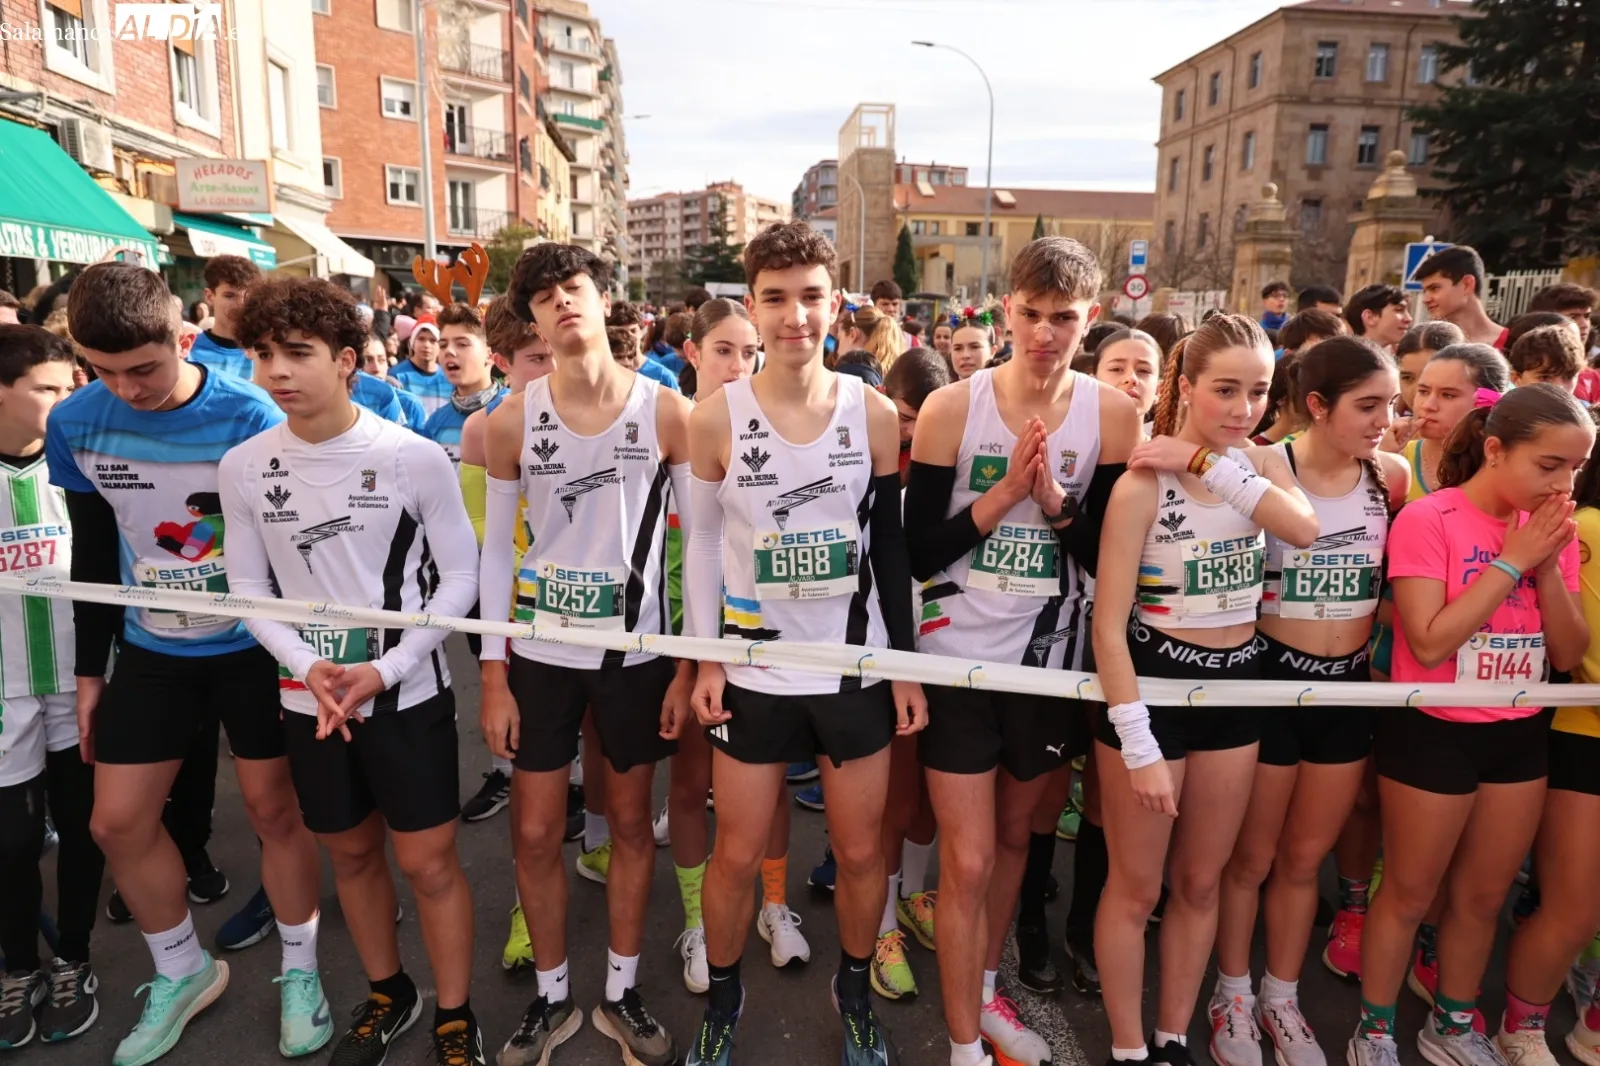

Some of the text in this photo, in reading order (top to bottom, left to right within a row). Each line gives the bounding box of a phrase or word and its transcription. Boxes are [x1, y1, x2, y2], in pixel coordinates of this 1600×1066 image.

[193, 163, 253, 180] HELADOS
[37, 226, 49, 258] &
[1130, 283, 1143, 291] 30
[531, 424, 558, 432] VIATOR
[739, 431, 769, 441] VIATOR
[613, 446, 650, 454] Ayuntamiento
[827, 450, 863, 460] Ayuntamiento
[544, 462, 567, 470] RURAL
[837, 458, 864, 467] Salamanca
[262, 470, 289, 479] VIATOR
[754, 473, 778, 481] RURAL
[348, 494, 389, 502] Ayuntamiento
[1, 525, 67, 543] SETEL
[781, 528, 847, 546] SETEL
[1000, 525, 1055, 541] SETEL
[1210, 535, 1262, 556] SETEL
[771, 546, 830, 577] 6198
[982, 538, 1044, 573] 6284
[1311, 553, 1375, 567] SETEL
[158, 561, 225, 581] SETEL
[555, 568, 615, 583] SETEL
[995, 568, 1021, 577] CARLOS
[1197, 551, 1255, 589] 6338
[1295, 568, 1361, 597] 6293
[545, 580, 601, 613] 6252
[1205, 587, 1234, 596] CANDELA
[1489, 637, 1543, 649] SETE
[1157, 640, 1225, 669] NIKE
[1226, 638, 1259, 668] PRO
[1279, 646, 1370, 676] NIKE PR
[1476, 652, 1532, 681] 6144
[164, 930, 195, 952] adida
